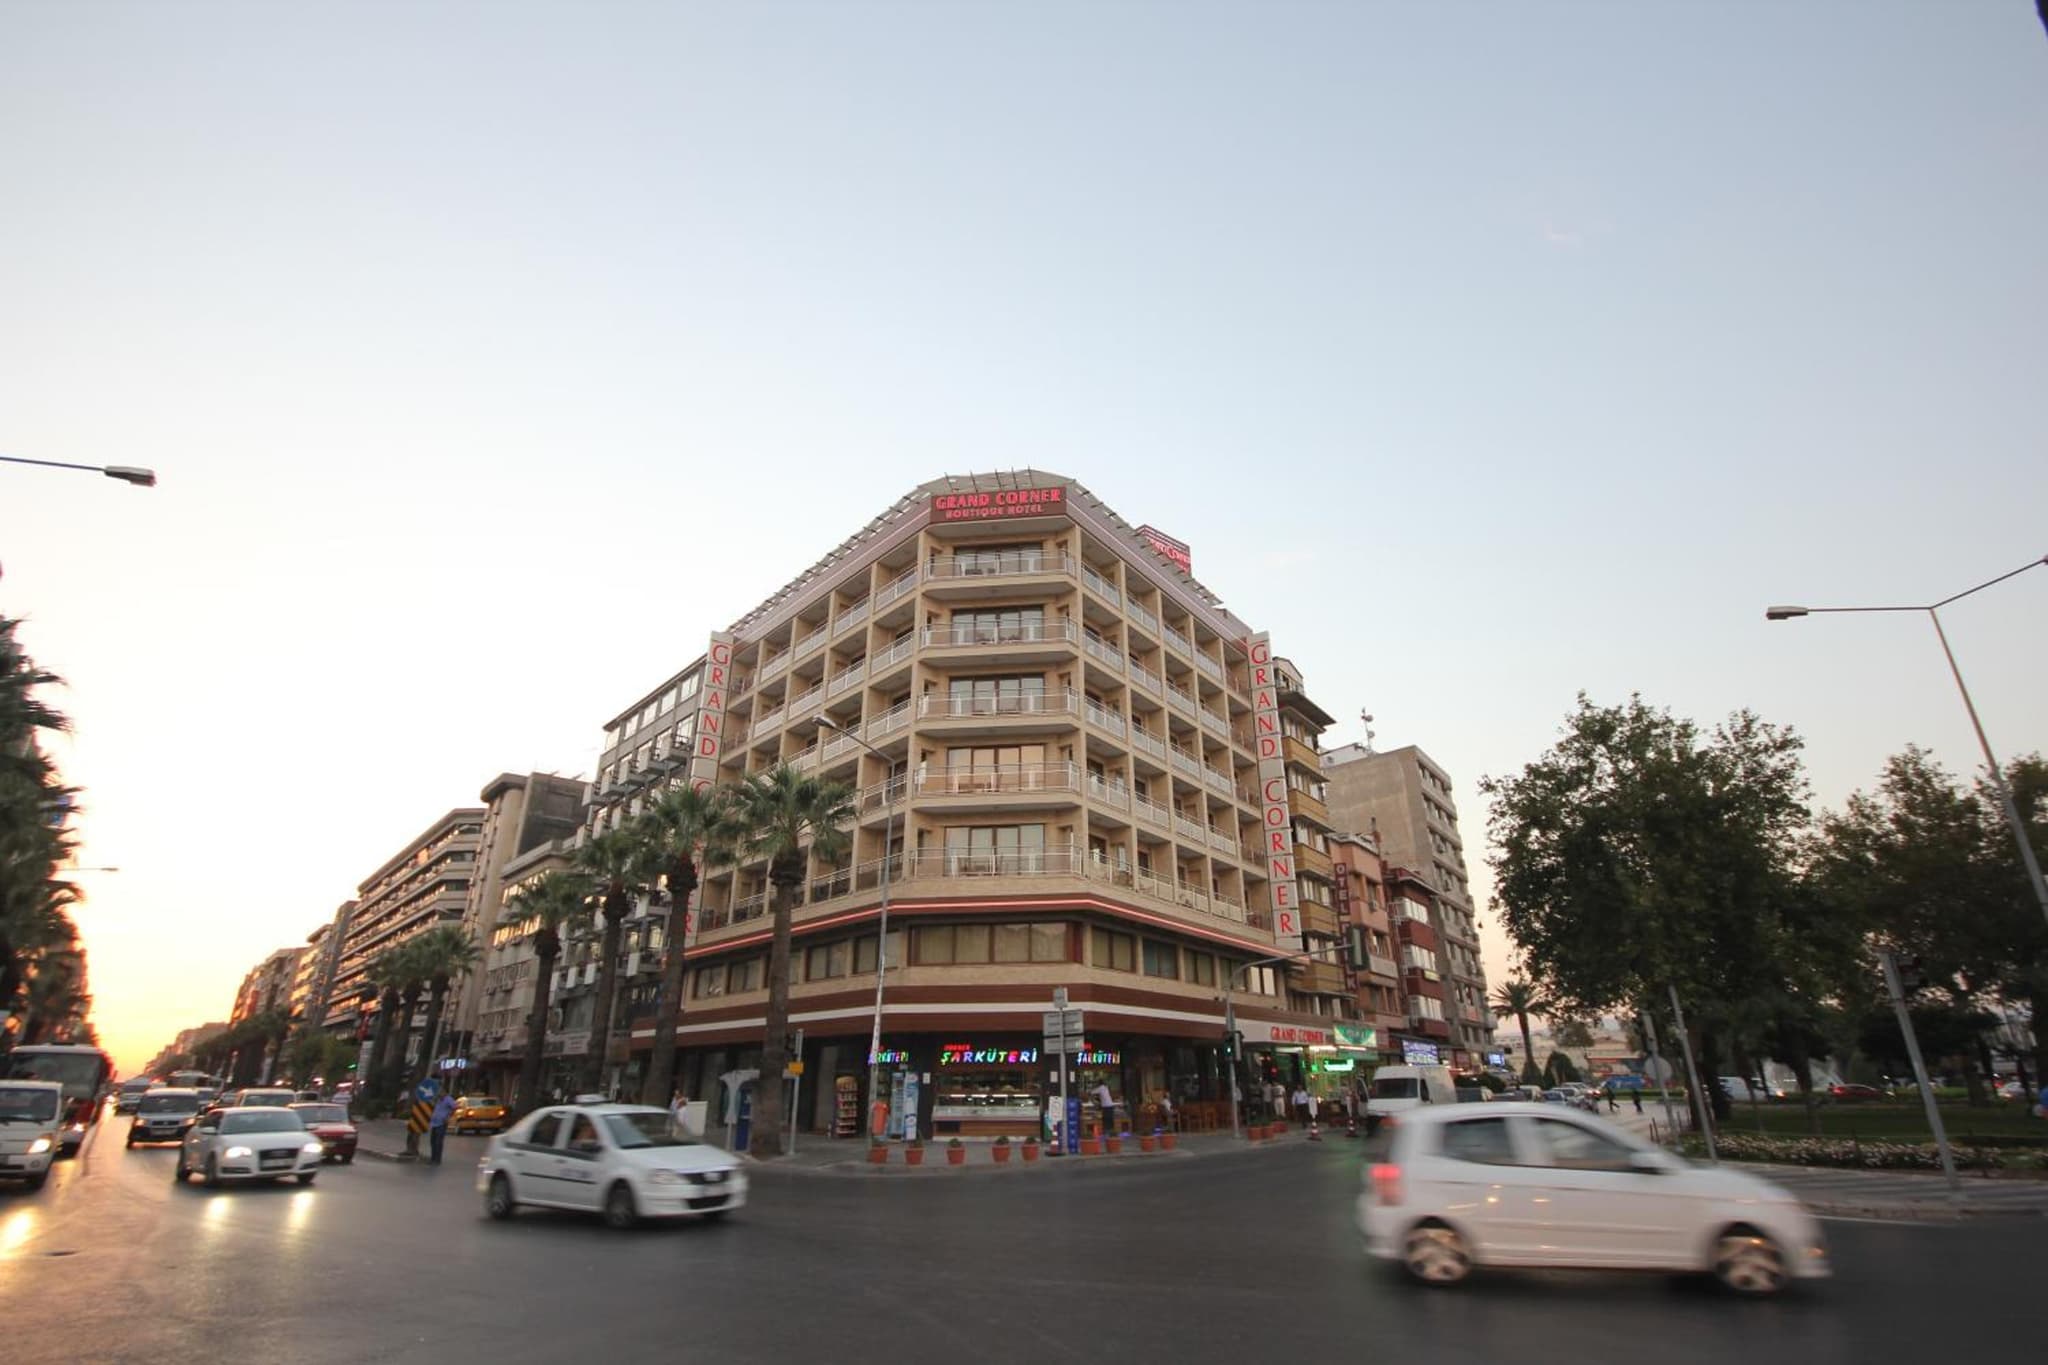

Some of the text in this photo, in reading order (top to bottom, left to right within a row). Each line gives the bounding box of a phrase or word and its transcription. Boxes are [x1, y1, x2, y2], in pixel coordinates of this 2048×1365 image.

[936, 489, 1060, 508] GRAND CORNER
[946, 505, 1043, 519] BOUTIQUE HOTEL
[701, 643, 729, 756] GRAND
[1251, 643, 1294, 934] GRAND CORNER
[1336, 863, 1349, 914] OTEL
[941, 1048, 1037, 1065] ŞARKÜTERİ
